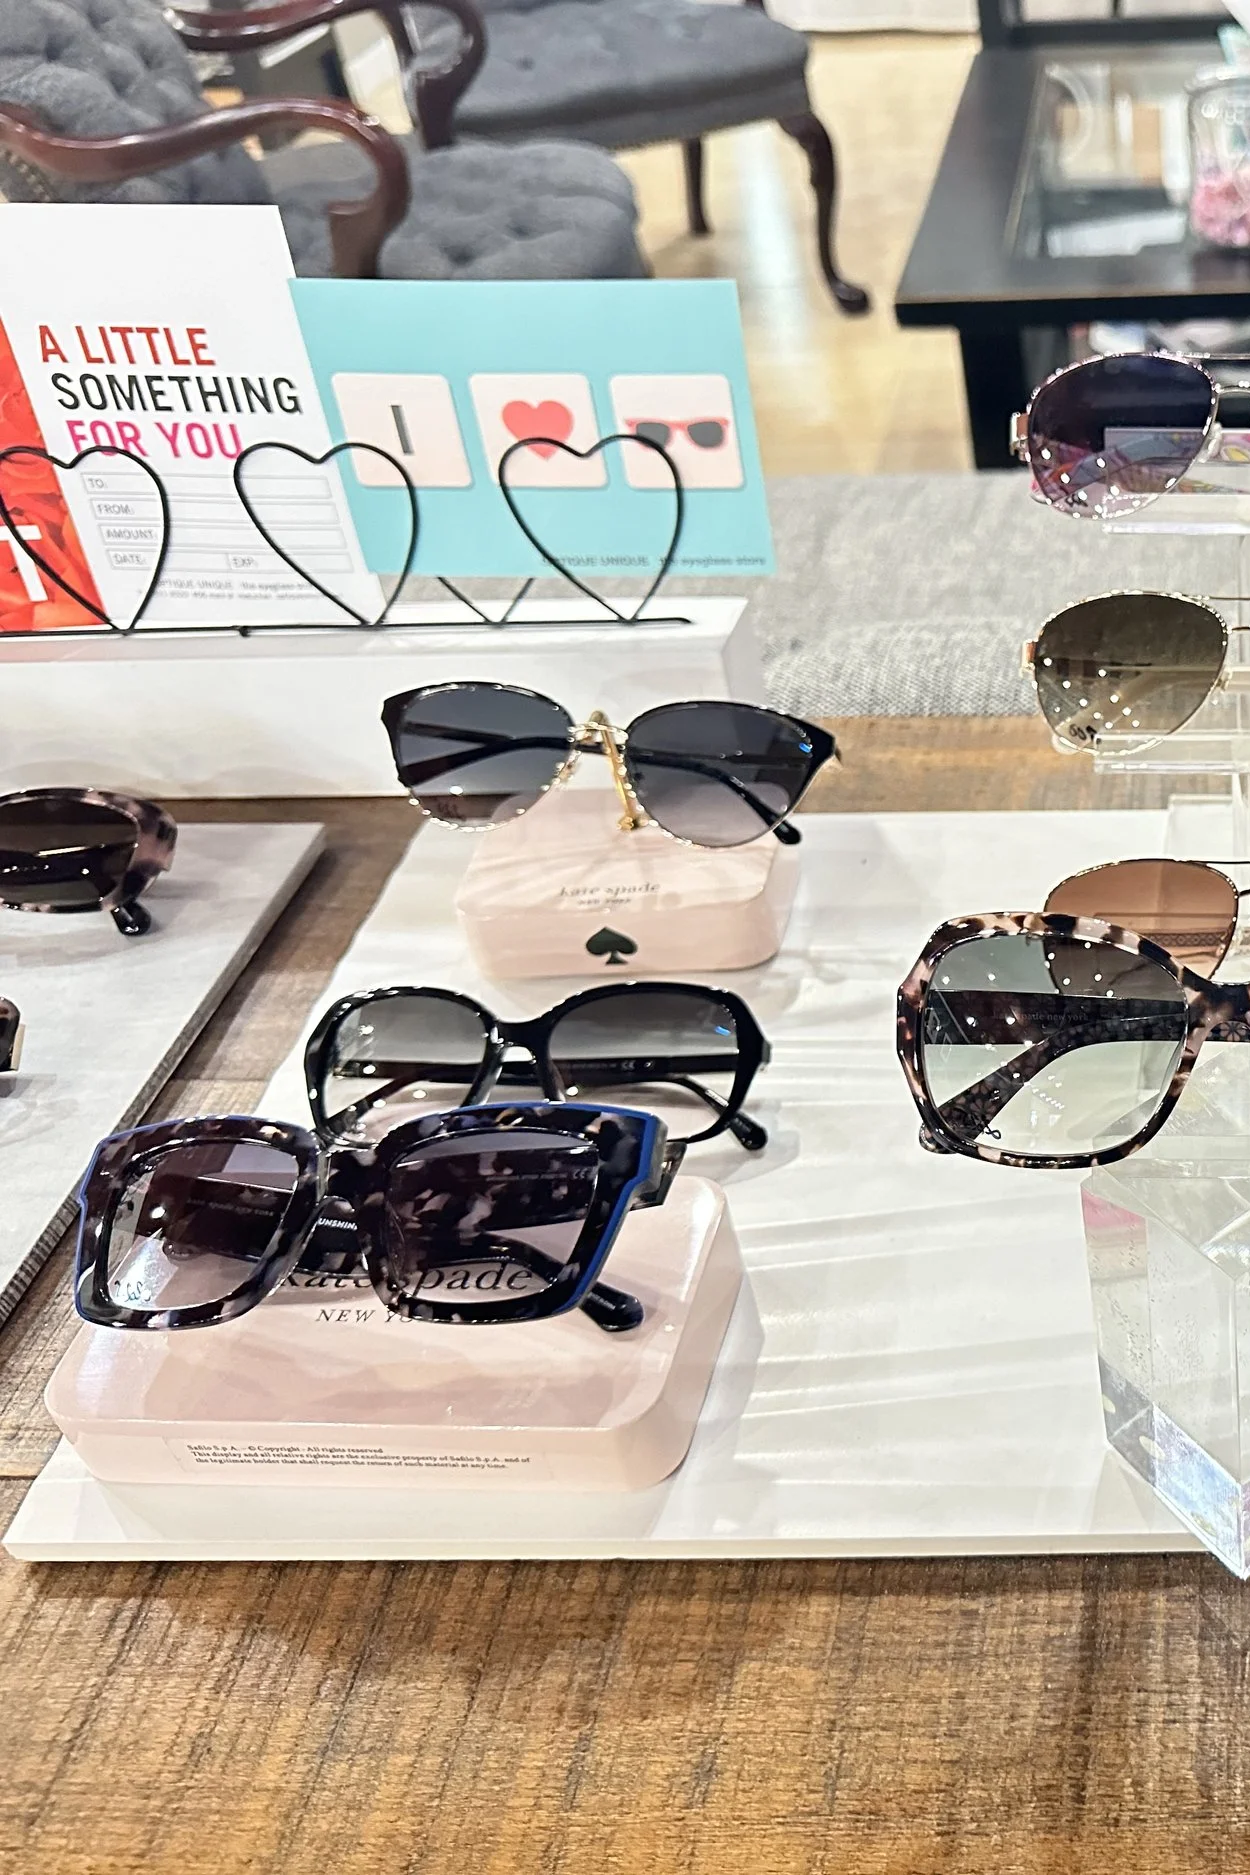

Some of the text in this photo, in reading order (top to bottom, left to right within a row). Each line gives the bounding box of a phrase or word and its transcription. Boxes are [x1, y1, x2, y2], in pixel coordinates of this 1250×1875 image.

[39, 325, 216, 366] A LITTLE
[51, 373, 304, 414] SOMETHING
[66, 420, 243, 459] FOR YOU
[318, 1217, 358, 1231] UNSHIN
[400, 1262, 533, 1298] pade
[315, 1309, 377, 1322] NEW
